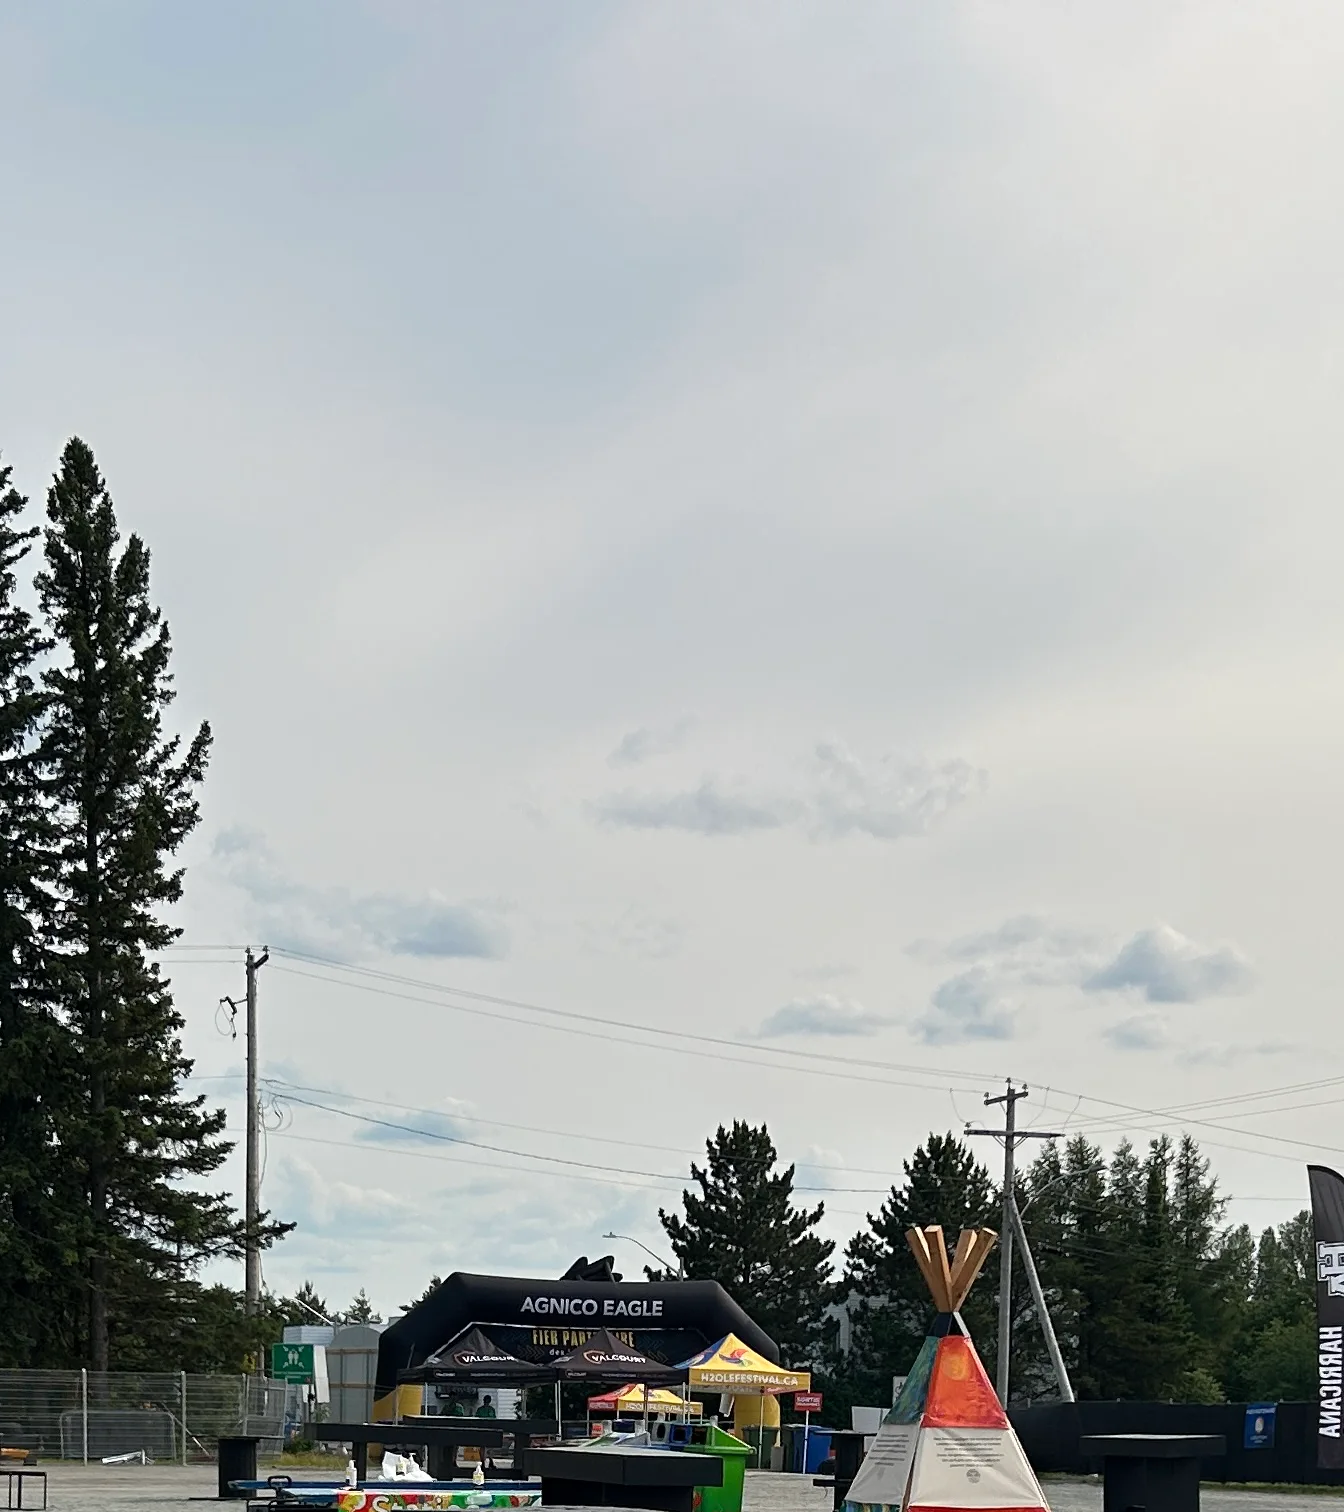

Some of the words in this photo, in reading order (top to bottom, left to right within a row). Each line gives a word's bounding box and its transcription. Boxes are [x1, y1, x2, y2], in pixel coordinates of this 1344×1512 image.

[520, 1296, 598, 1316] AGNICO
[603, 1300, 664, 1317] EAGLE
[532, 1329, 559, 1346] FIER
